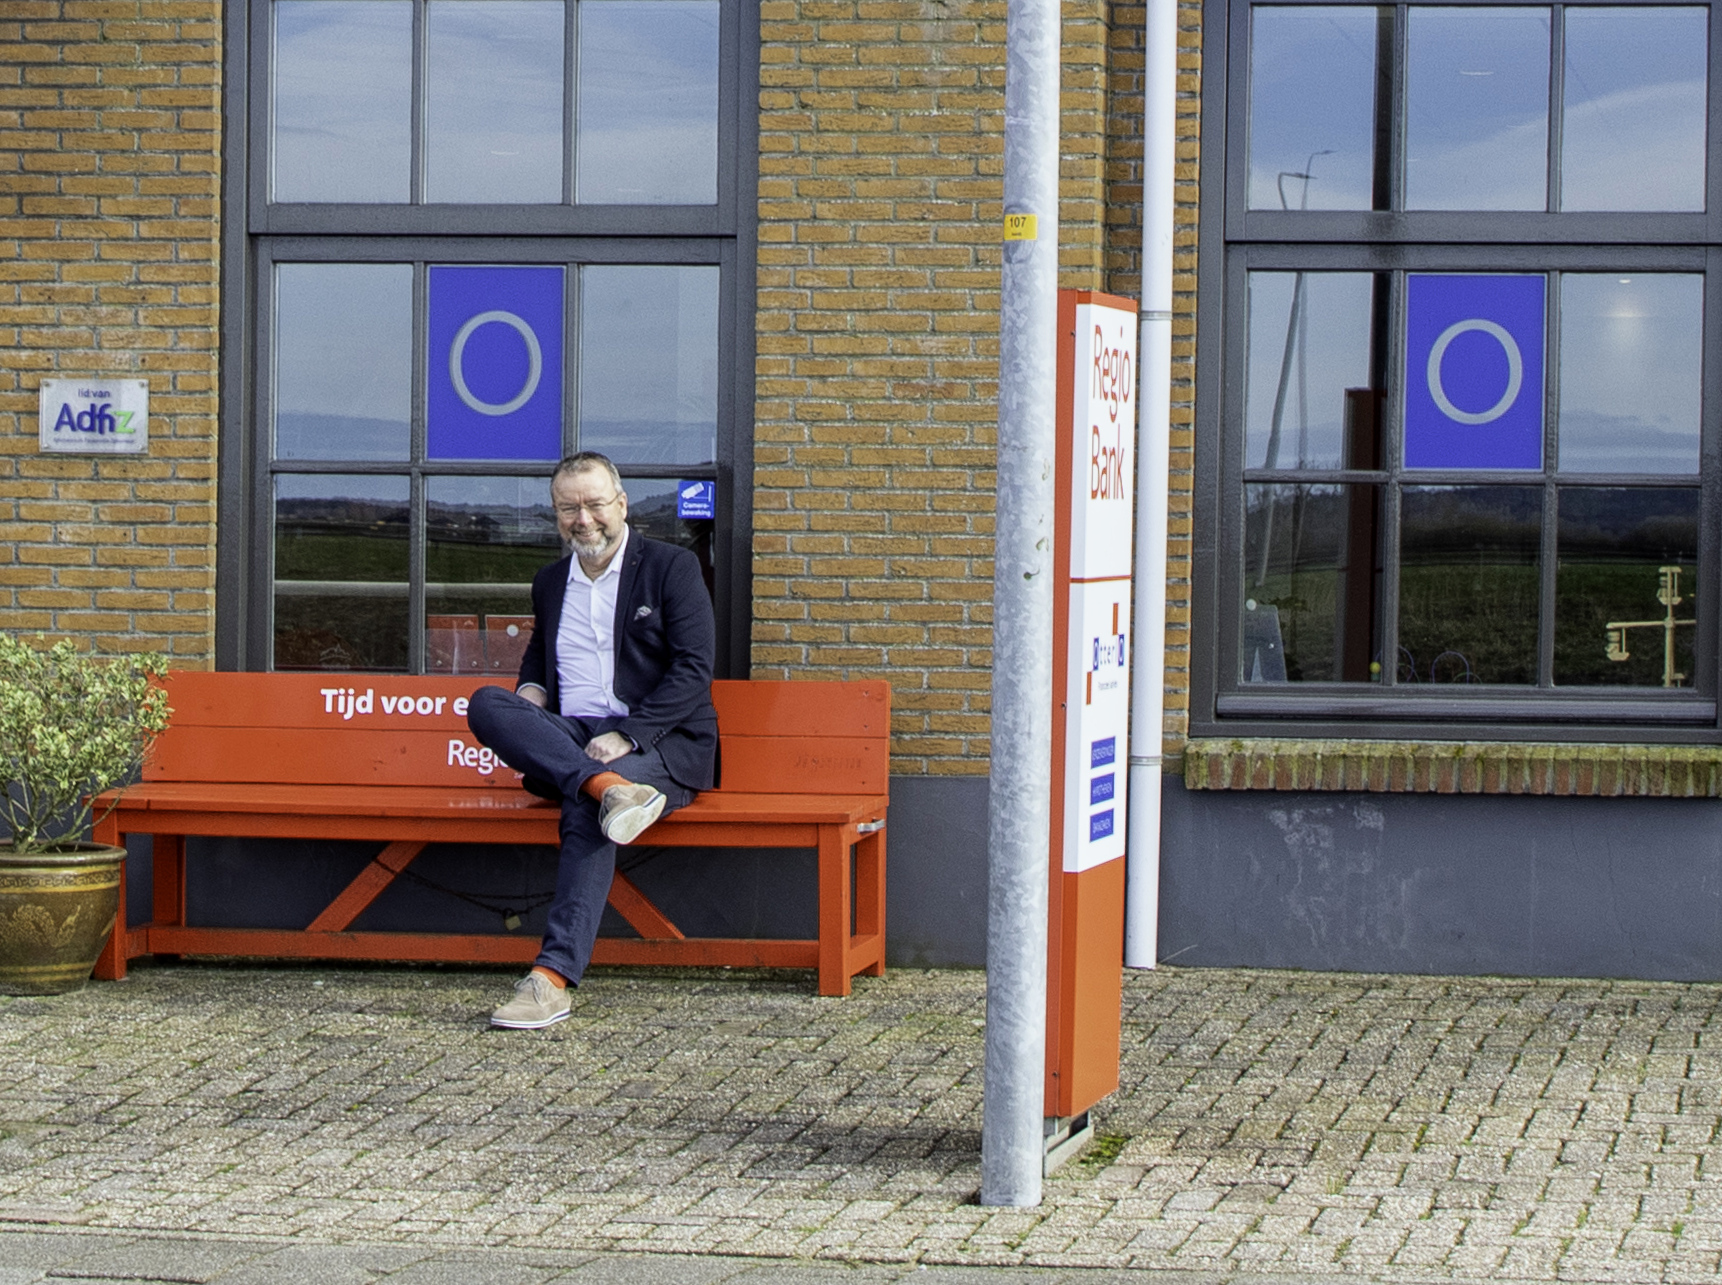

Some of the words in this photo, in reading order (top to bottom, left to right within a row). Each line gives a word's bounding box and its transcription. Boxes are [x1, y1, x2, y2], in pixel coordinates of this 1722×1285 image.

[1009, 216, 1027, 228] 107
[1092, 324, 1131, 423] Regio
[1090, 423, 1125, 500] Bank
[320, 688, 374, 720] Tijd
[380, 695, 447, 715] voor
